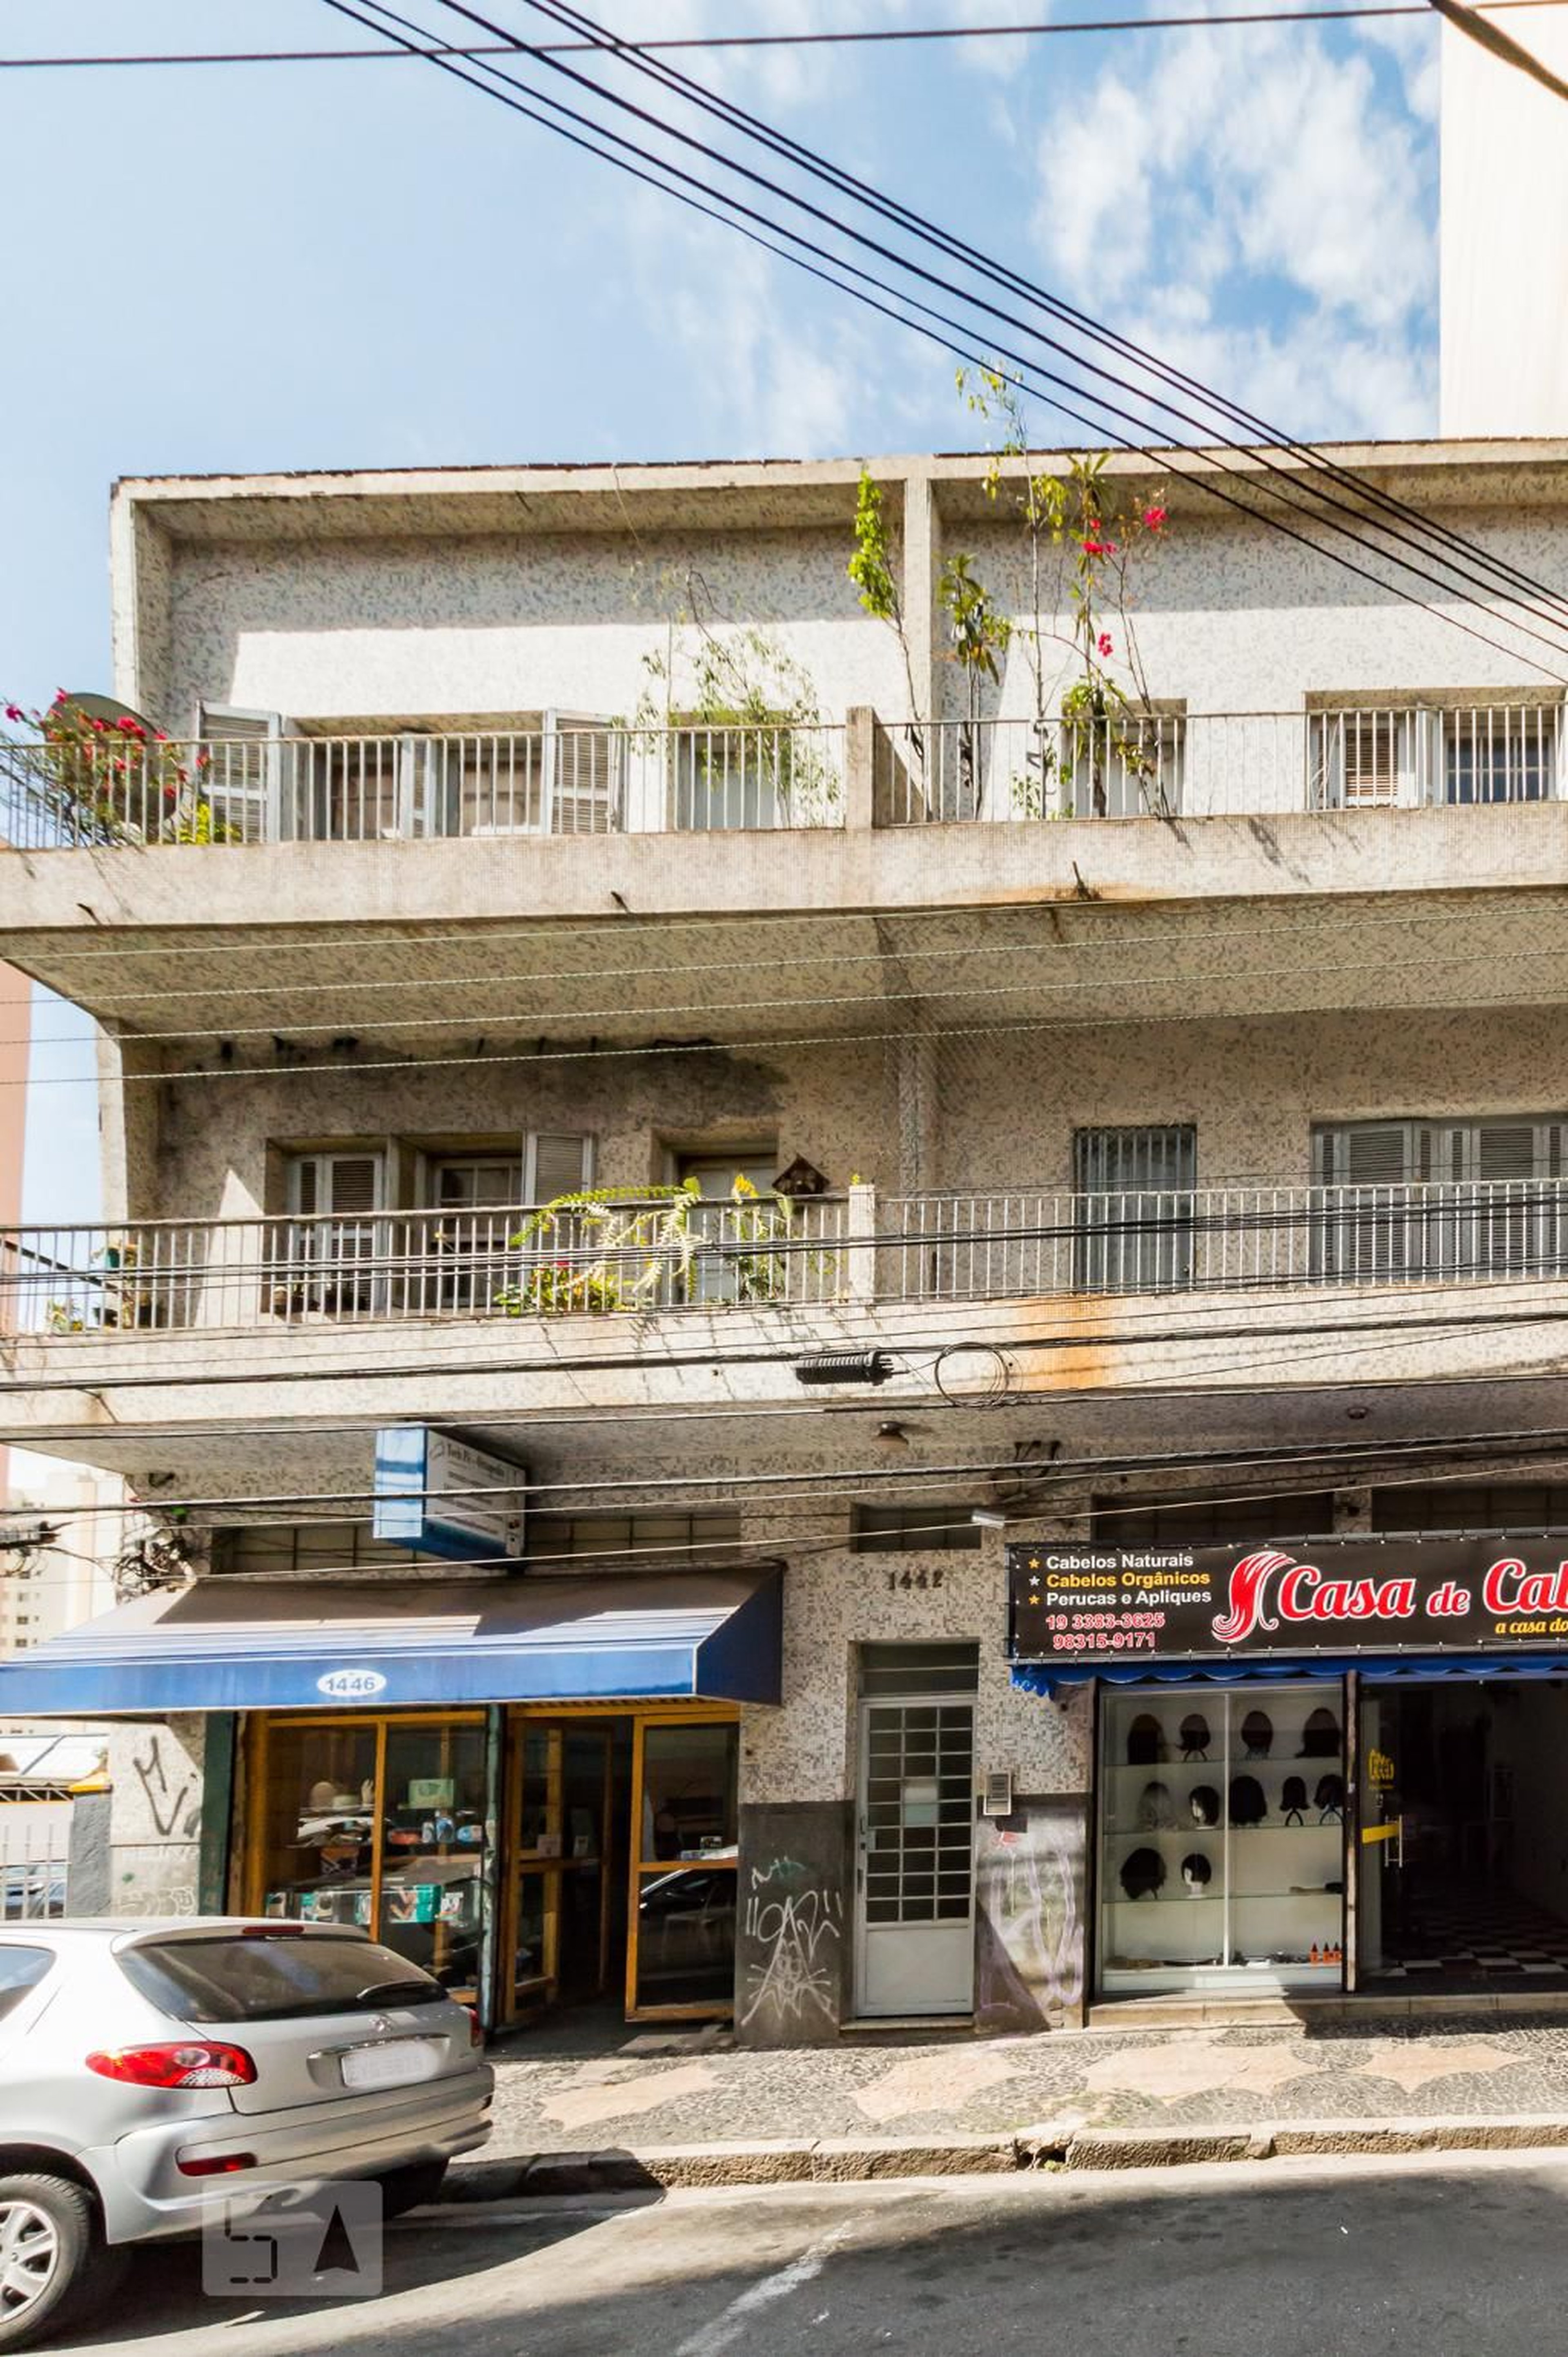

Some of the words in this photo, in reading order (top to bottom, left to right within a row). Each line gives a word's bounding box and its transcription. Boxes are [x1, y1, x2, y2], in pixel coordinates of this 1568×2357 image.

[1046, 1555, 1117, 1569] Cabelos
[1121, 1552, 1194, 1568] Naturais
[1046, 1574, 1117, 1588] Cabelos
[1121, 1571, 1211, 1589] Orgânicos
[1046, 1592, 1117, 1606] Perucas
[1121, 1594, 1131, 1604] e
[1135, 1590, 1212, 1607] Apliques
[1278, 1565, 1416, 1621] Casa
[1426, 1581, 1471, 1617] de
[1046, 1614, 1068, 1630] 19
[1072, 1612, 1165, 1629] 3383-3625
[1495, 1622, 1507, 1634] a
[1510, 1621, 1547, 1634] casa
[327, 1677, 375, 1691] 1446
